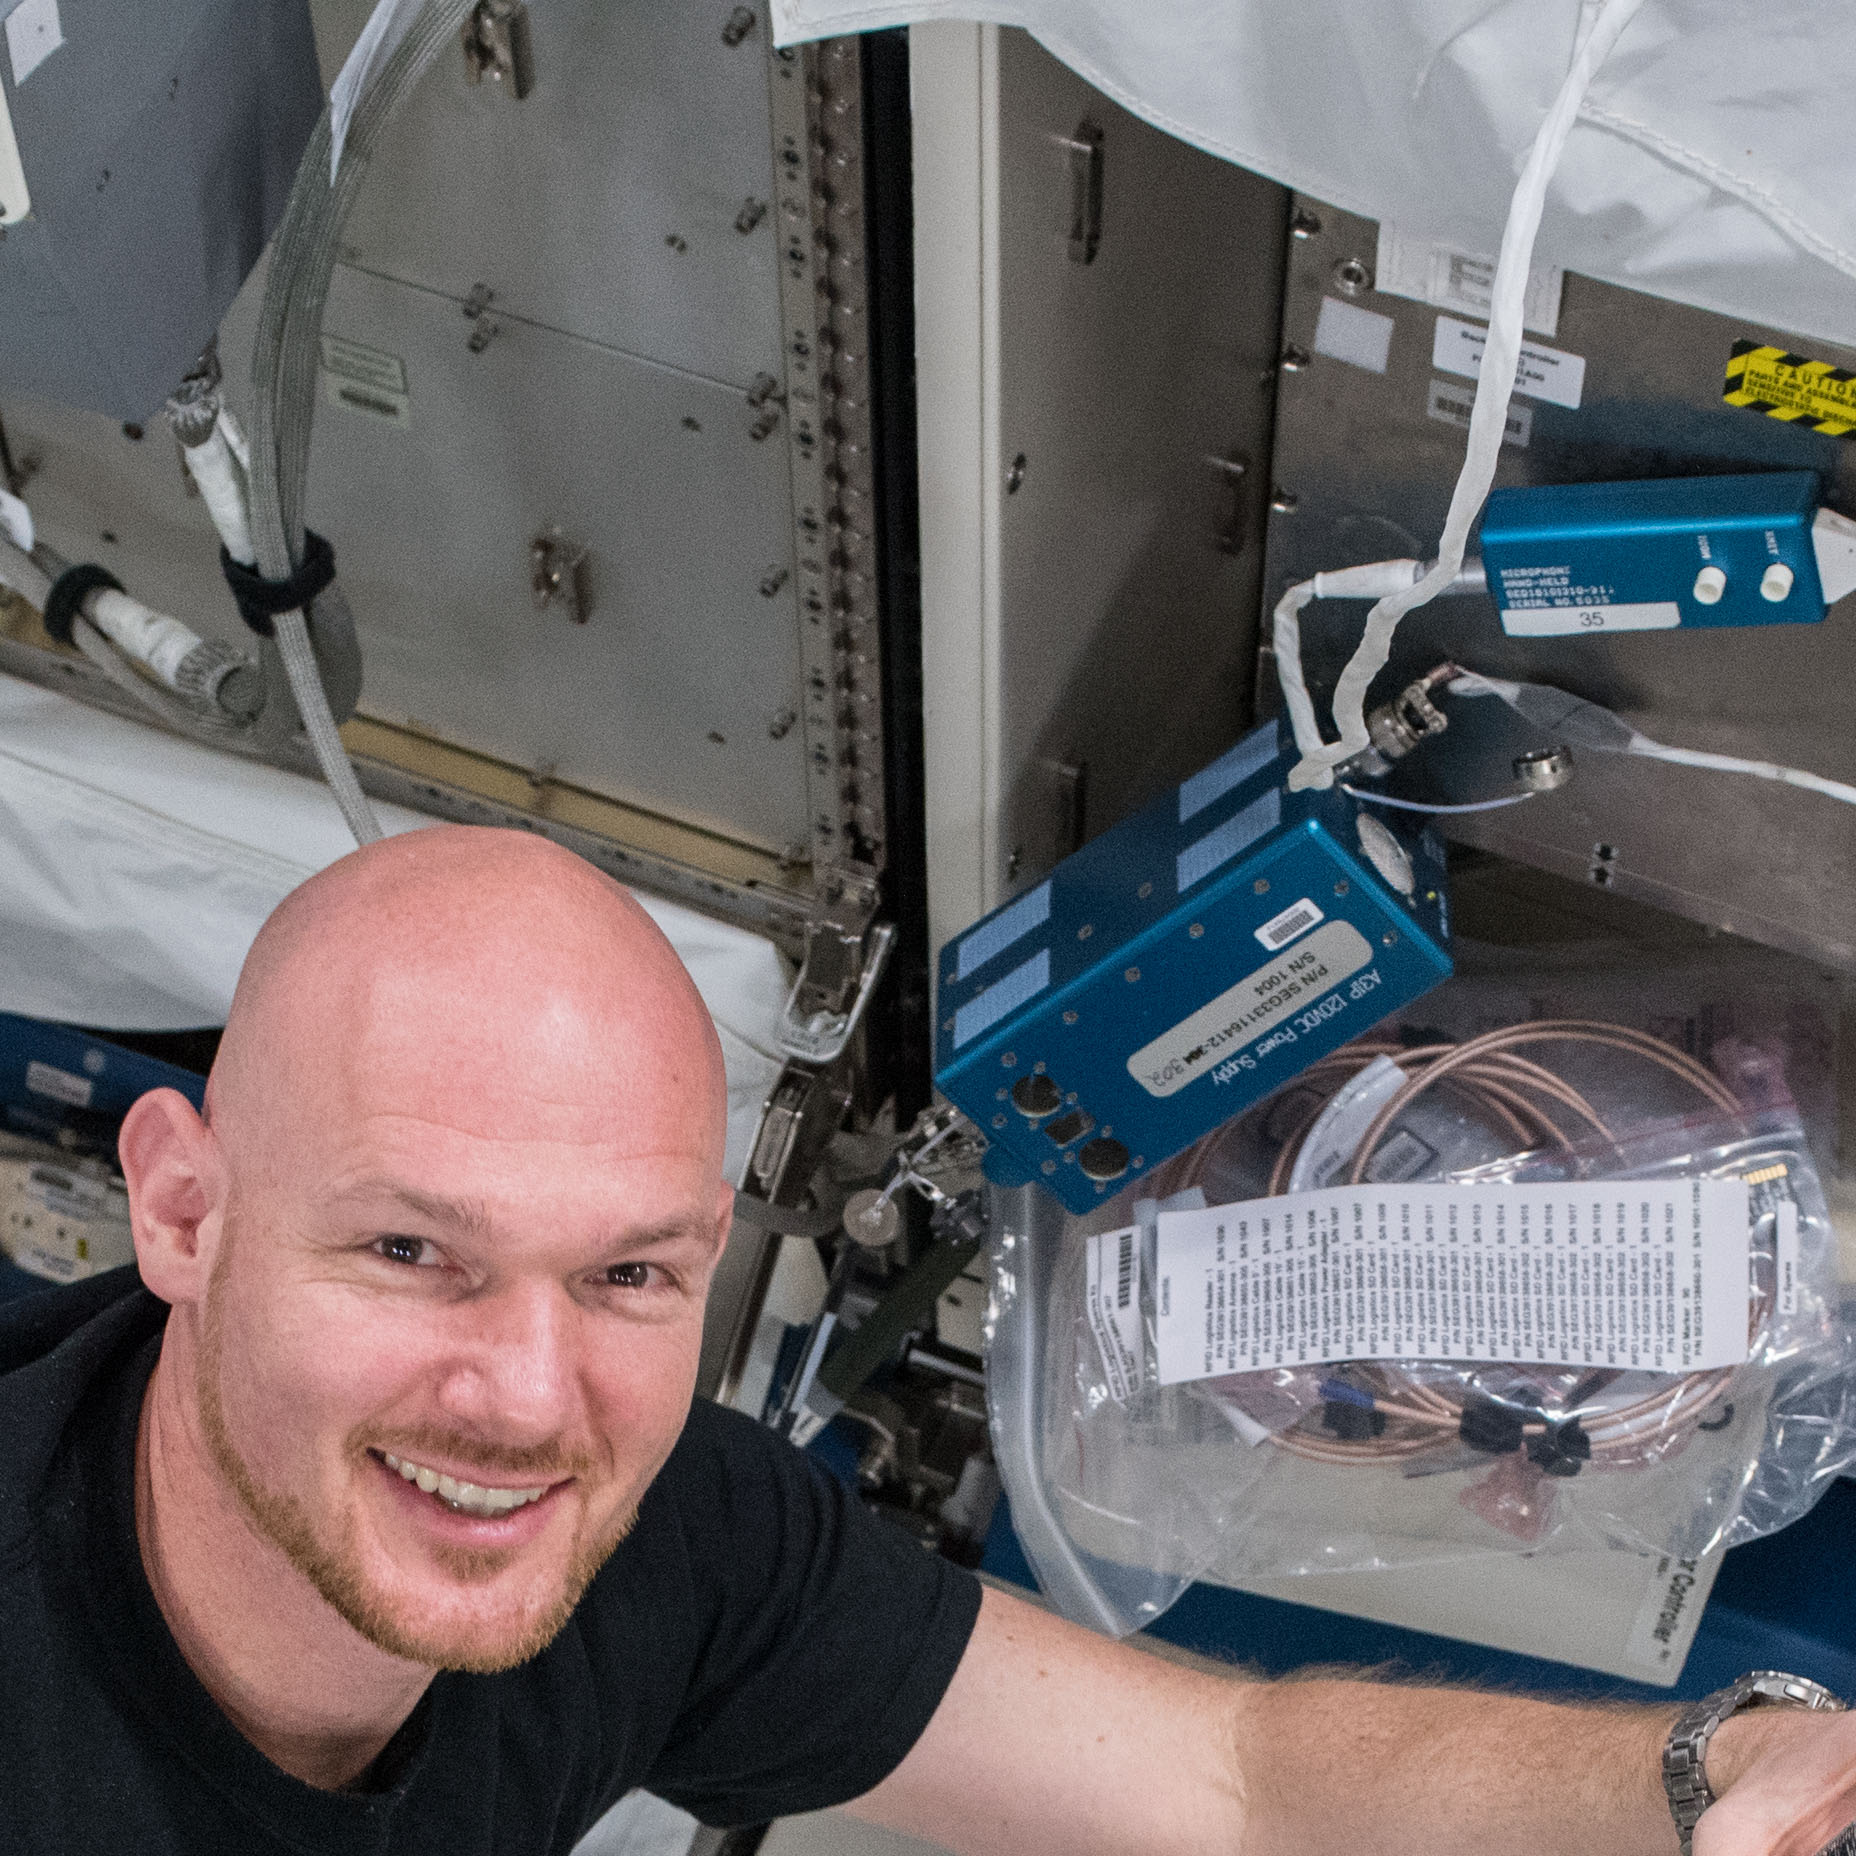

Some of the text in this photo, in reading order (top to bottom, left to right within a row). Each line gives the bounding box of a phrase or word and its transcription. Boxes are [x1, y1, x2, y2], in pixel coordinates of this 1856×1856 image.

[1578, 610, 1606, 629] 35
[1252, 949, 1316, 997] S/N 1004
[1299, 961, 1328, 986] P/N
[1207, 966, 1383, 1089] A31P 120VDC Power Supply
[1783, 1262, 1791, 1291] Spares
[1682, 1307, 1690, 1338] Marker
[1652, 1571, 1696, 1644] Controller
